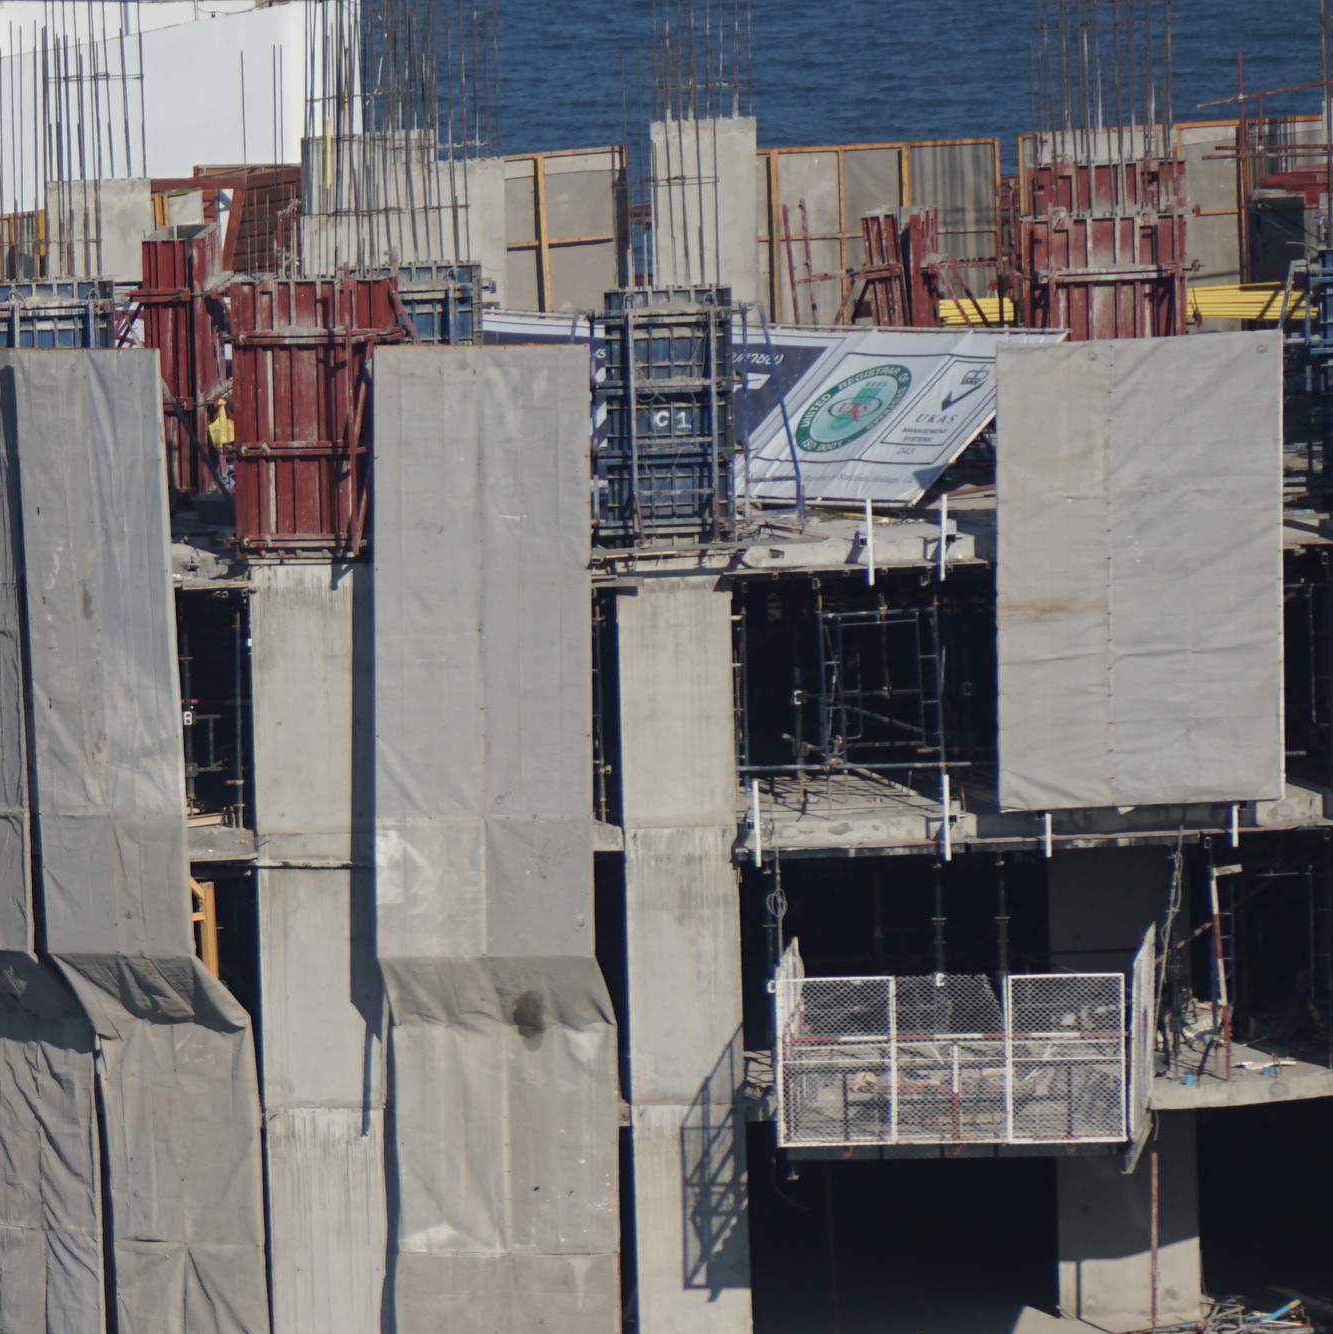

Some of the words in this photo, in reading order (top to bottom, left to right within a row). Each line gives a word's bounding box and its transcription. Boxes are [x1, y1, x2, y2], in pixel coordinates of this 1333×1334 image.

[799, 393, 832, 428] UNITED
[838, 366, 902, 391] REGISTRAR
[915, 413, 959, 424] UKAS
